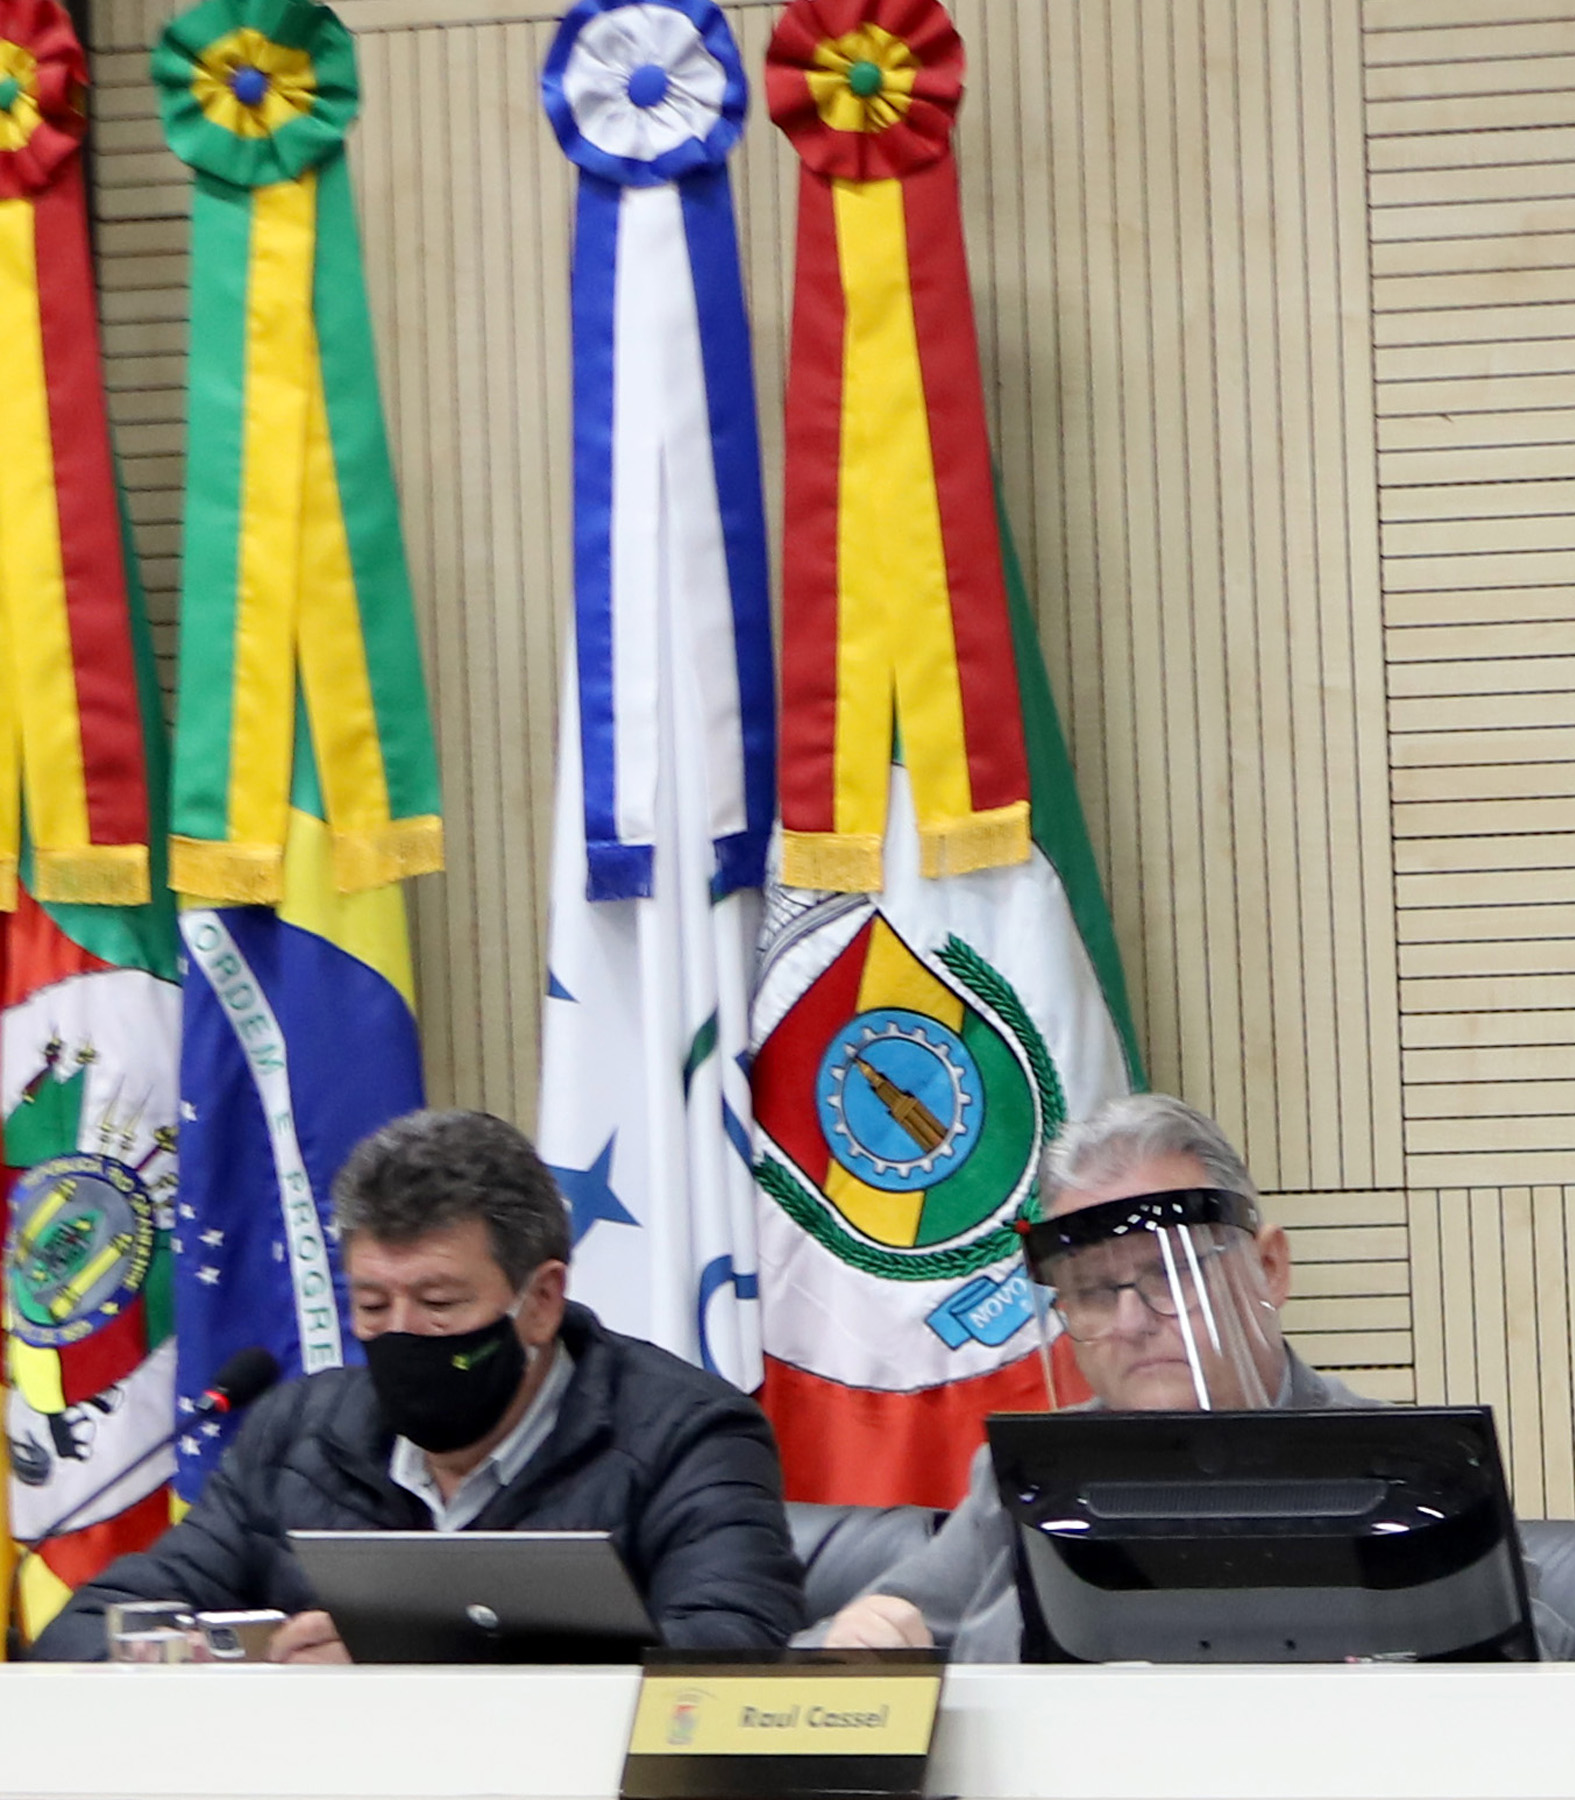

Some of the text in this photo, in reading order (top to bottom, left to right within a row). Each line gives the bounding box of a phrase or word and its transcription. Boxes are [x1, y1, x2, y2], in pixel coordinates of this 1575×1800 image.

[195, 924, 286, 1076] ORDEM
[968, 1276, 1028, 1330] NOVO
[739, 1703, 889, 1729] Raul Cassel
